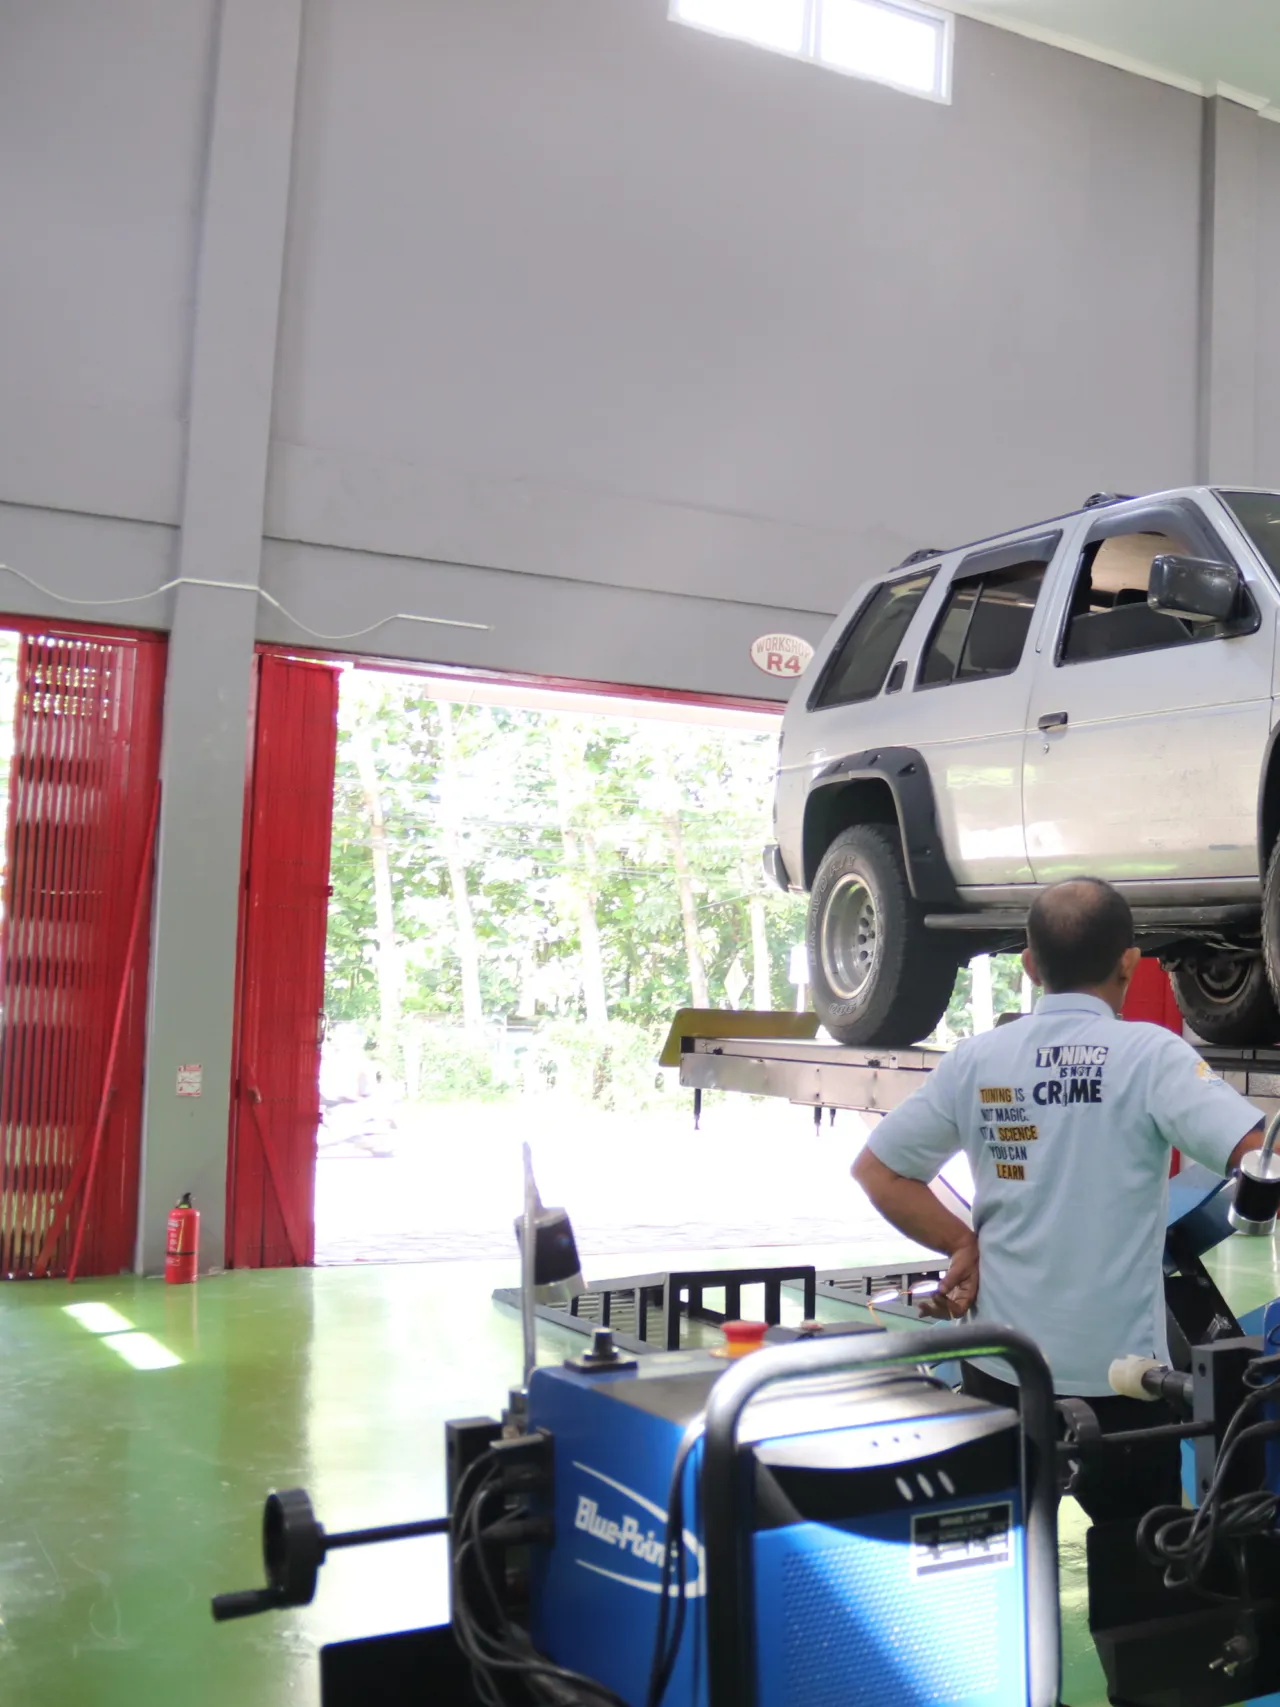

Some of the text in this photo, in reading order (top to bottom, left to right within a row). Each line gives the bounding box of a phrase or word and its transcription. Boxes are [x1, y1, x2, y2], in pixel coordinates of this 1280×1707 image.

[767, 652, 801, 673] R4
[1038, 1045, 1107, 1069] TUNING
[1060, 1066, 1102, 1078] IS NOT A
[980, 1088, 1025, 1103] TUNING IS
[1033, 1079, 1102, 1107] CRIME
[998, 1125, 1038, 1142] SCIENCE
[989, 1145, 1028, 1160] YOU CAN
[996, 1163, 1025, 1180] LEARN
